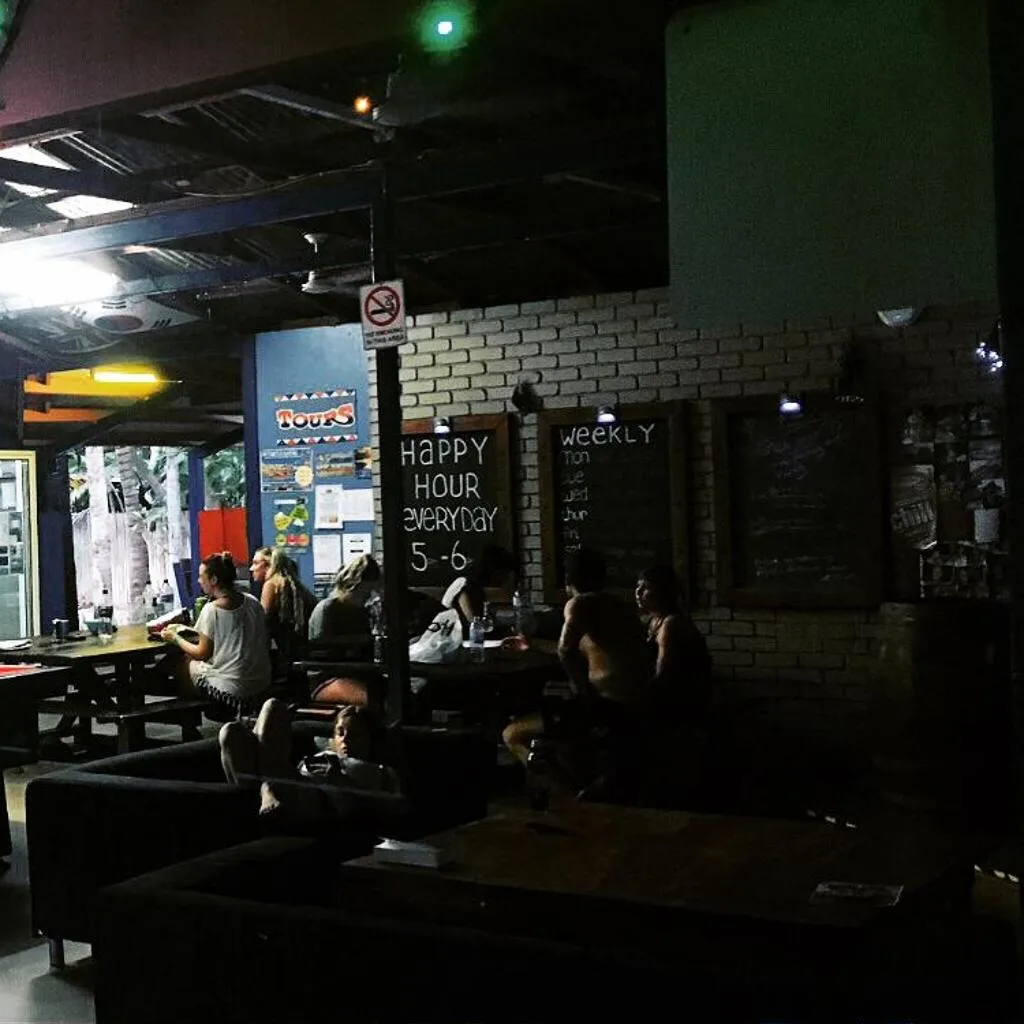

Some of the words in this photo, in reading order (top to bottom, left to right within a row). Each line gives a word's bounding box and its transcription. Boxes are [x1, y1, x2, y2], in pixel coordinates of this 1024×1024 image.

[276, 403, 355, 430] TOURS
[414, 472, 481, 500] HOUR
[411, 541, 429, 572] 5
